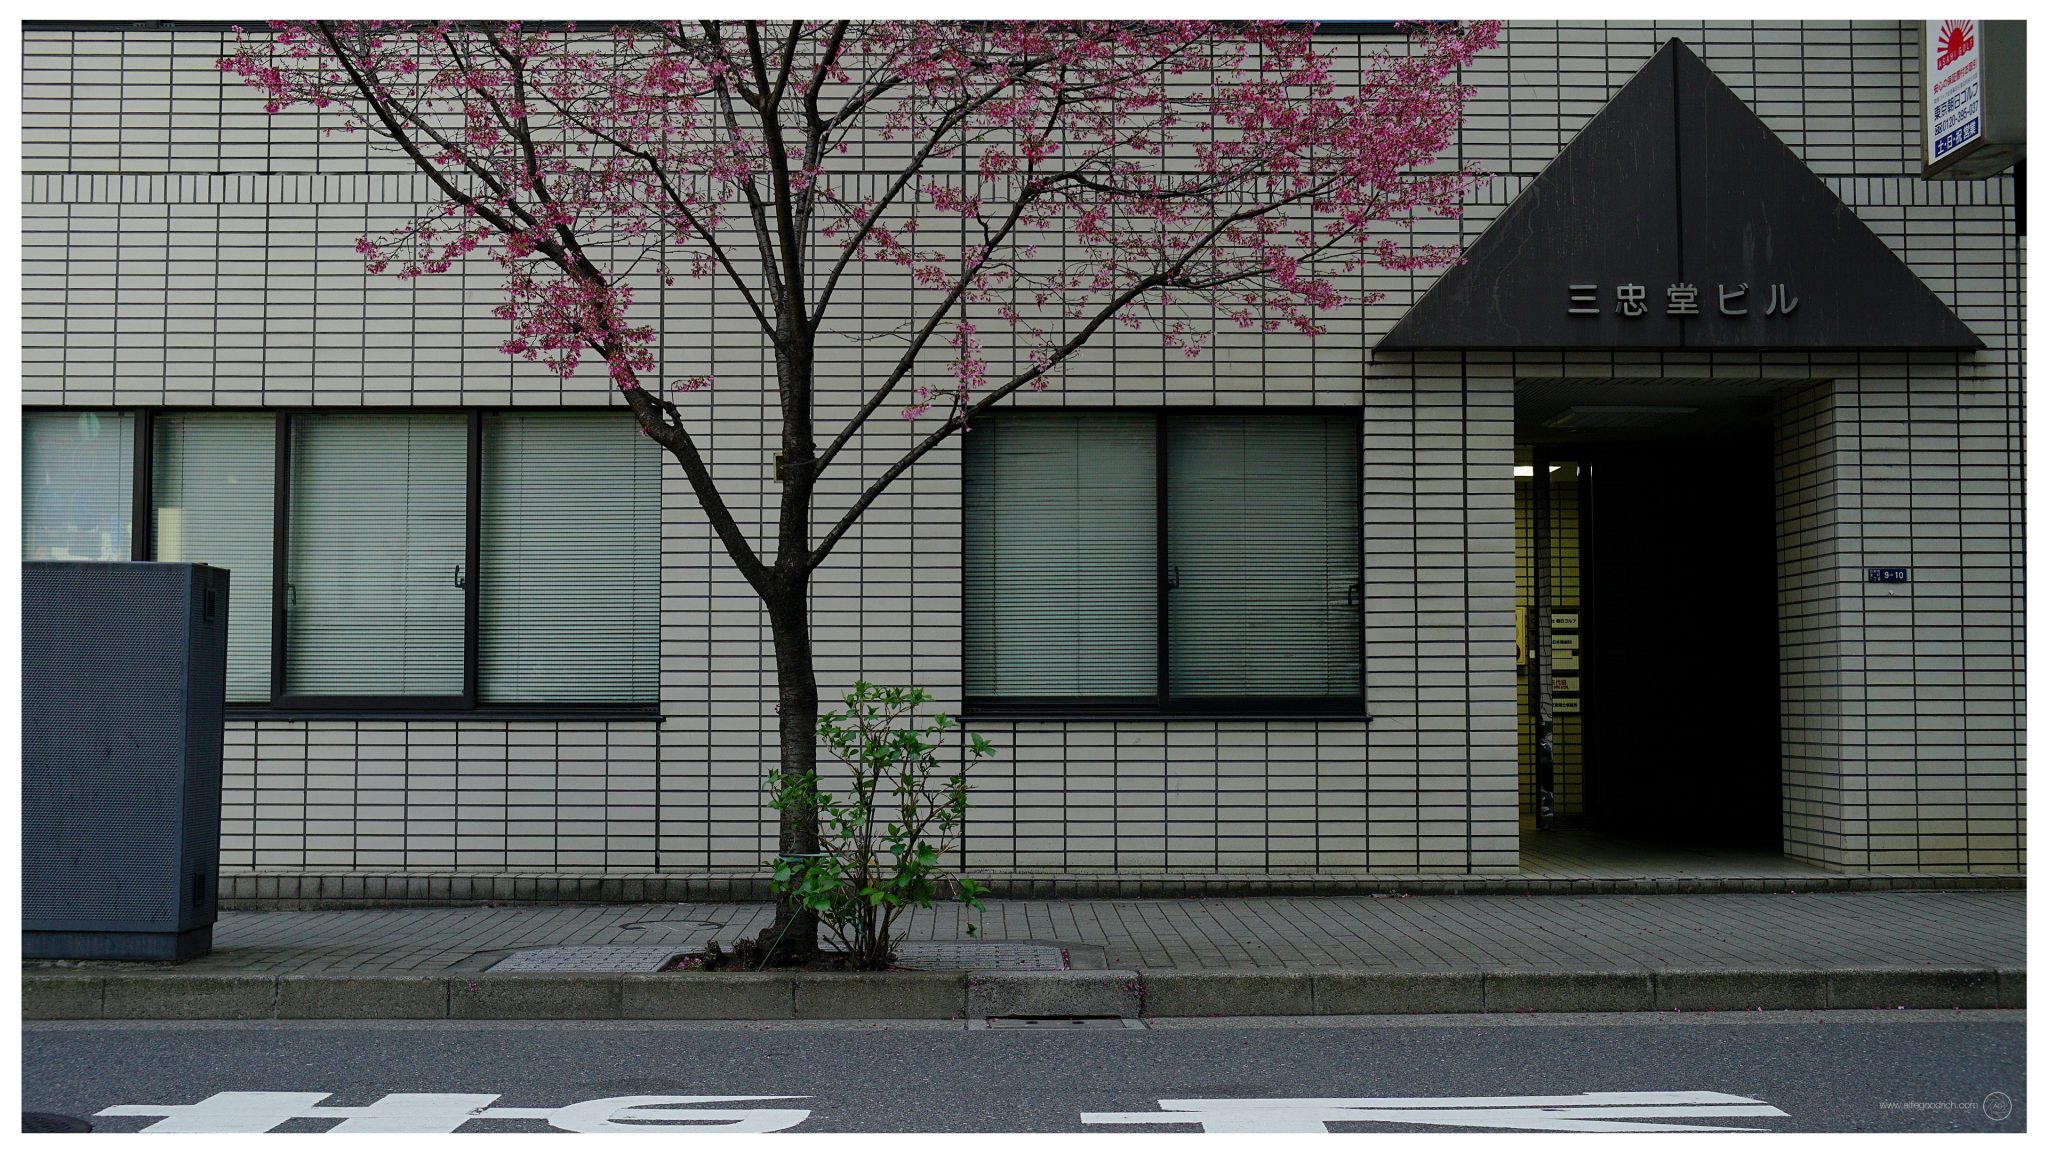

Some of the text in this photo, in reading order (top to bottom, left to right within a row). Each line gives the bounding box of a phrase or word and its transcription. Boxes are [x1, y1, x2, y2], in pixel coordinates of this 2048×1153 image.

[1938, 38, 1973, 68] ASAHI GOLF
[1934, 82, 1978, 121] 東京朝日ゴルフ
[1567, 282, 1799, 317] 三忠堂ビル
[1884, 571, 1904, 579] 9-10
